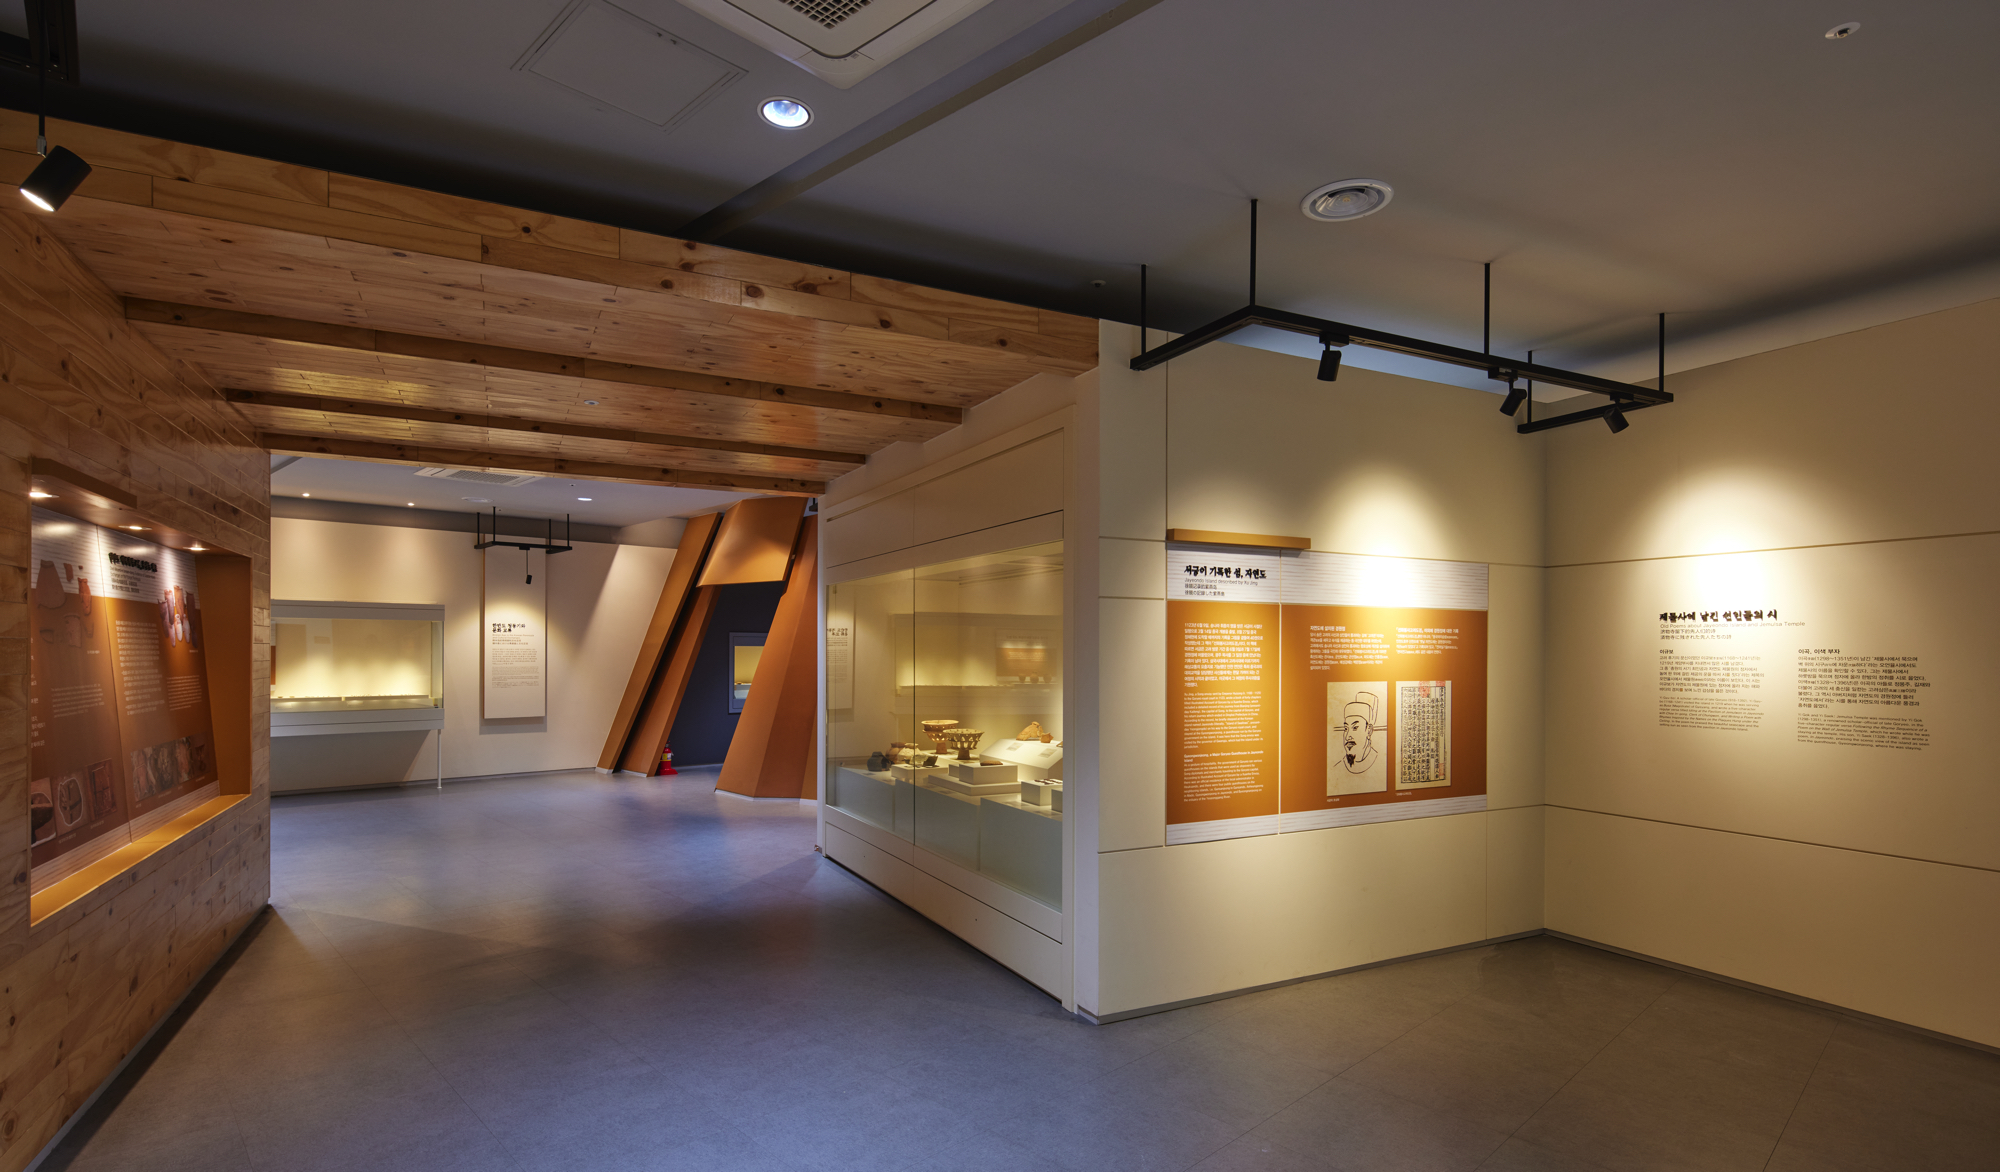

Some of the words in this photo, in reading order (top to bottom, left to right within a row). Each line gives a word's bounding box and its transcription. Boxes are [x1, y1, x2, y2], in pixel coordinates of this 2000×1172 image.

[1184, 565, 1207, 577] 서긍이
[1209, 566, 1232, 578] 기록한
[1245, 568, 1267, 580] 자연도
[1659, 611, 1696, 623] 제물사에
[1700, 611, 1718, 622] 남긴
[1722, 610, 1763, 621] 선인들의
[1767, 610, 1777, 620] 시
